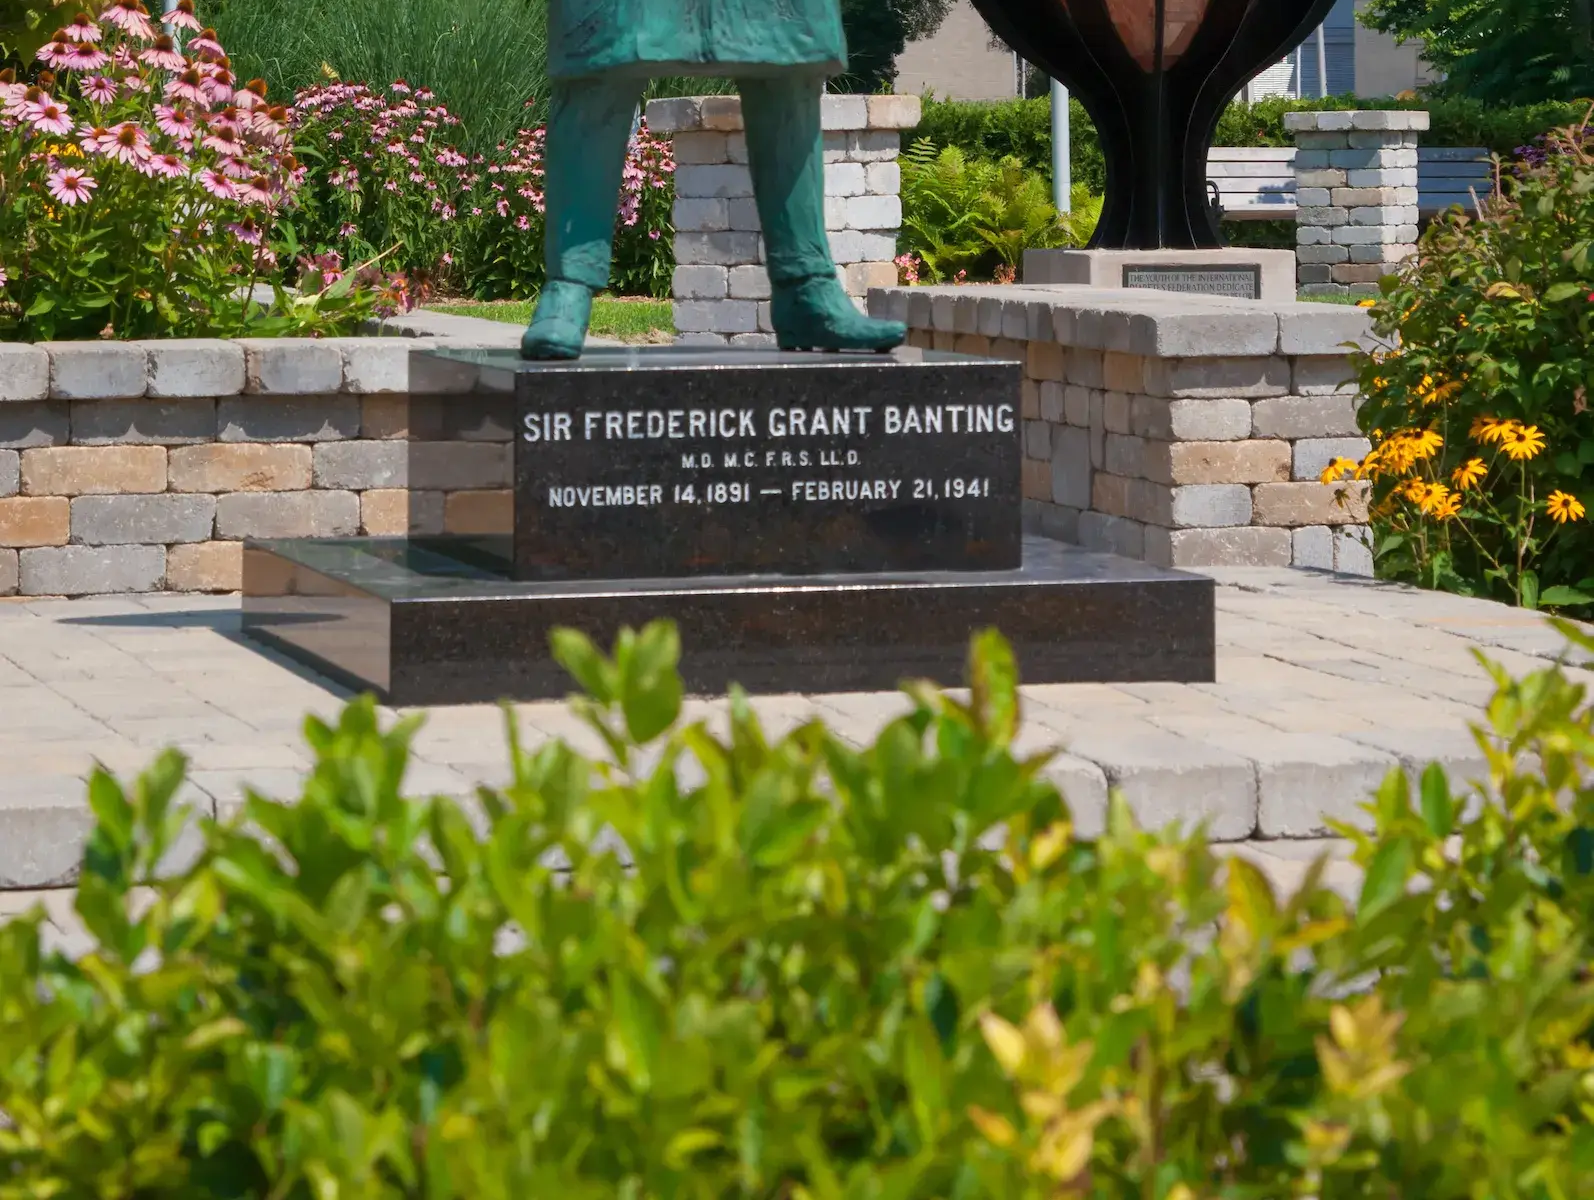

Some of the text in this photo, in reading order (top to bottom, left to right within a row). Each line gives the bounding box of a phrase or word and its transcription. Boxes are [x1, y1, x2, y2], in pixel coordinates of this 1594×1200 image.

[1146, 274, 1170, 282] YOUTH
[1198, 274, 1253, 282] INTERNATIONAL
[1167, 283, 1214, 292] FEDERATION
[1217, 283, 1254, 291] DEDICATE
[524, 404, 1014, 442] SIR FREDERICK GRANT BANTING
[549, 484, 663, 507] NOVEMBER
[792, 479, 901, 501] FEBRUARY
